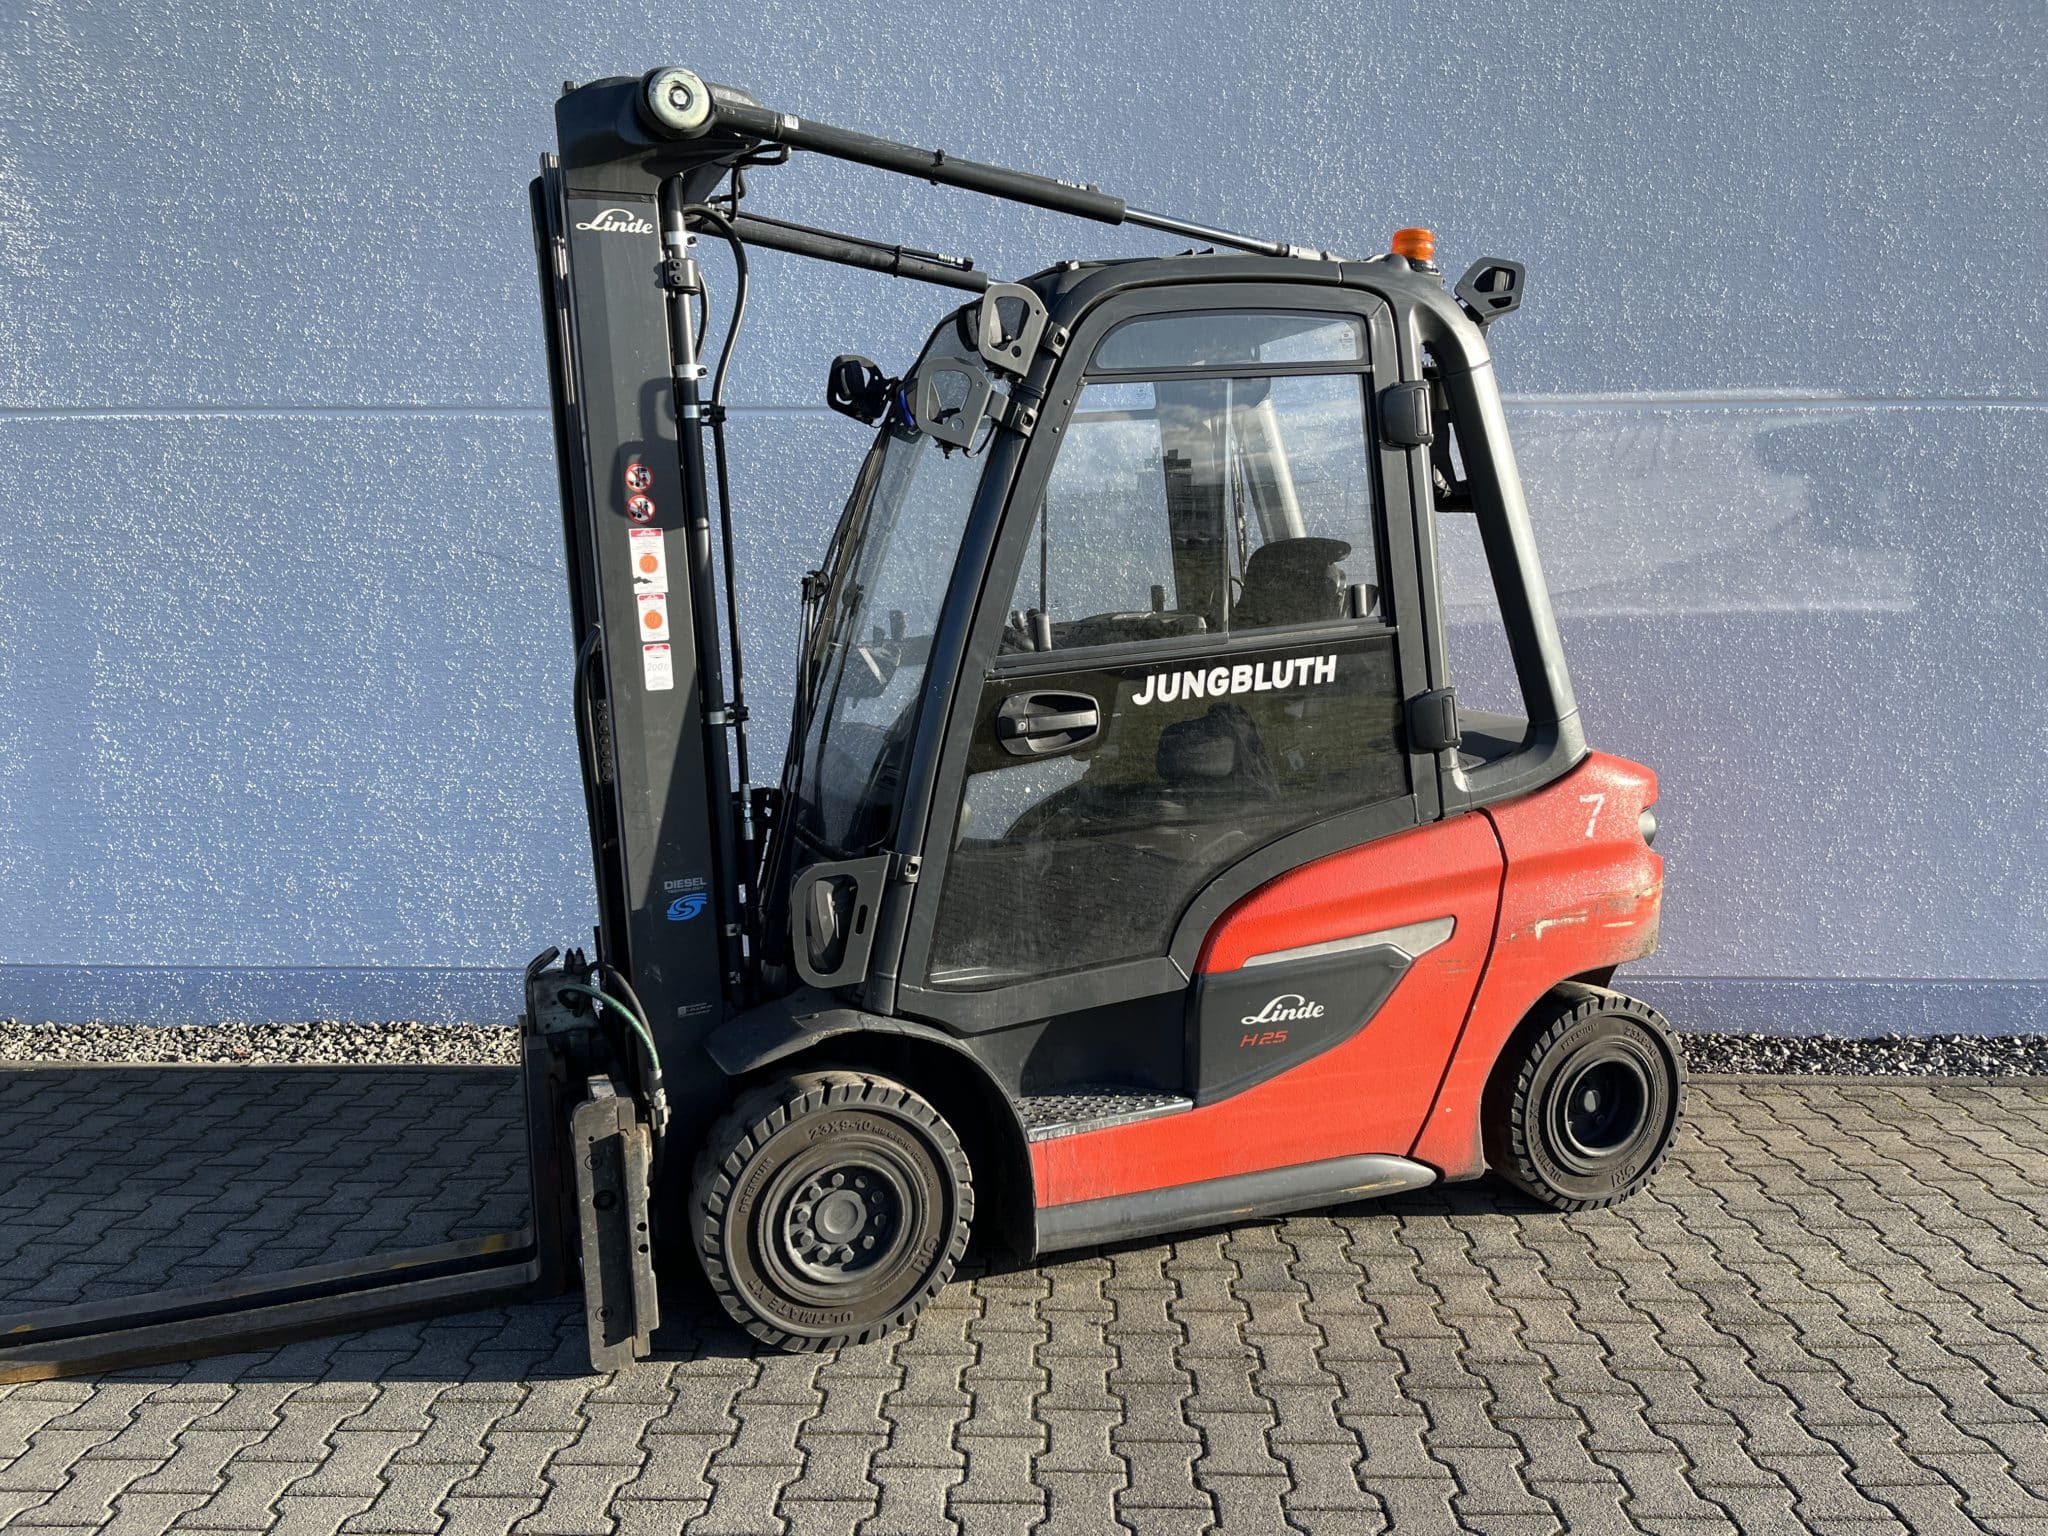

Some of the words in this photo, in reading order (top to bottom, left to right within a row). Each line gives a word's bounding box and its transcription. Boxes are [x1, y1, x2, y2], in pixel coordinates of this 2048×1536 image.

[575, 208, 654, 235] Linde
[1131, 654, 1338, 706] JUNGBLUTH
[1578, 792, 1606, 839] 7
[663, 877, 708, 891] DIESEL
[1241, 994, 1325, 1025] Linde
[913, 1235, 940, 1277] GRI
[766, 1297, 854, 1324] ULTIMATE
